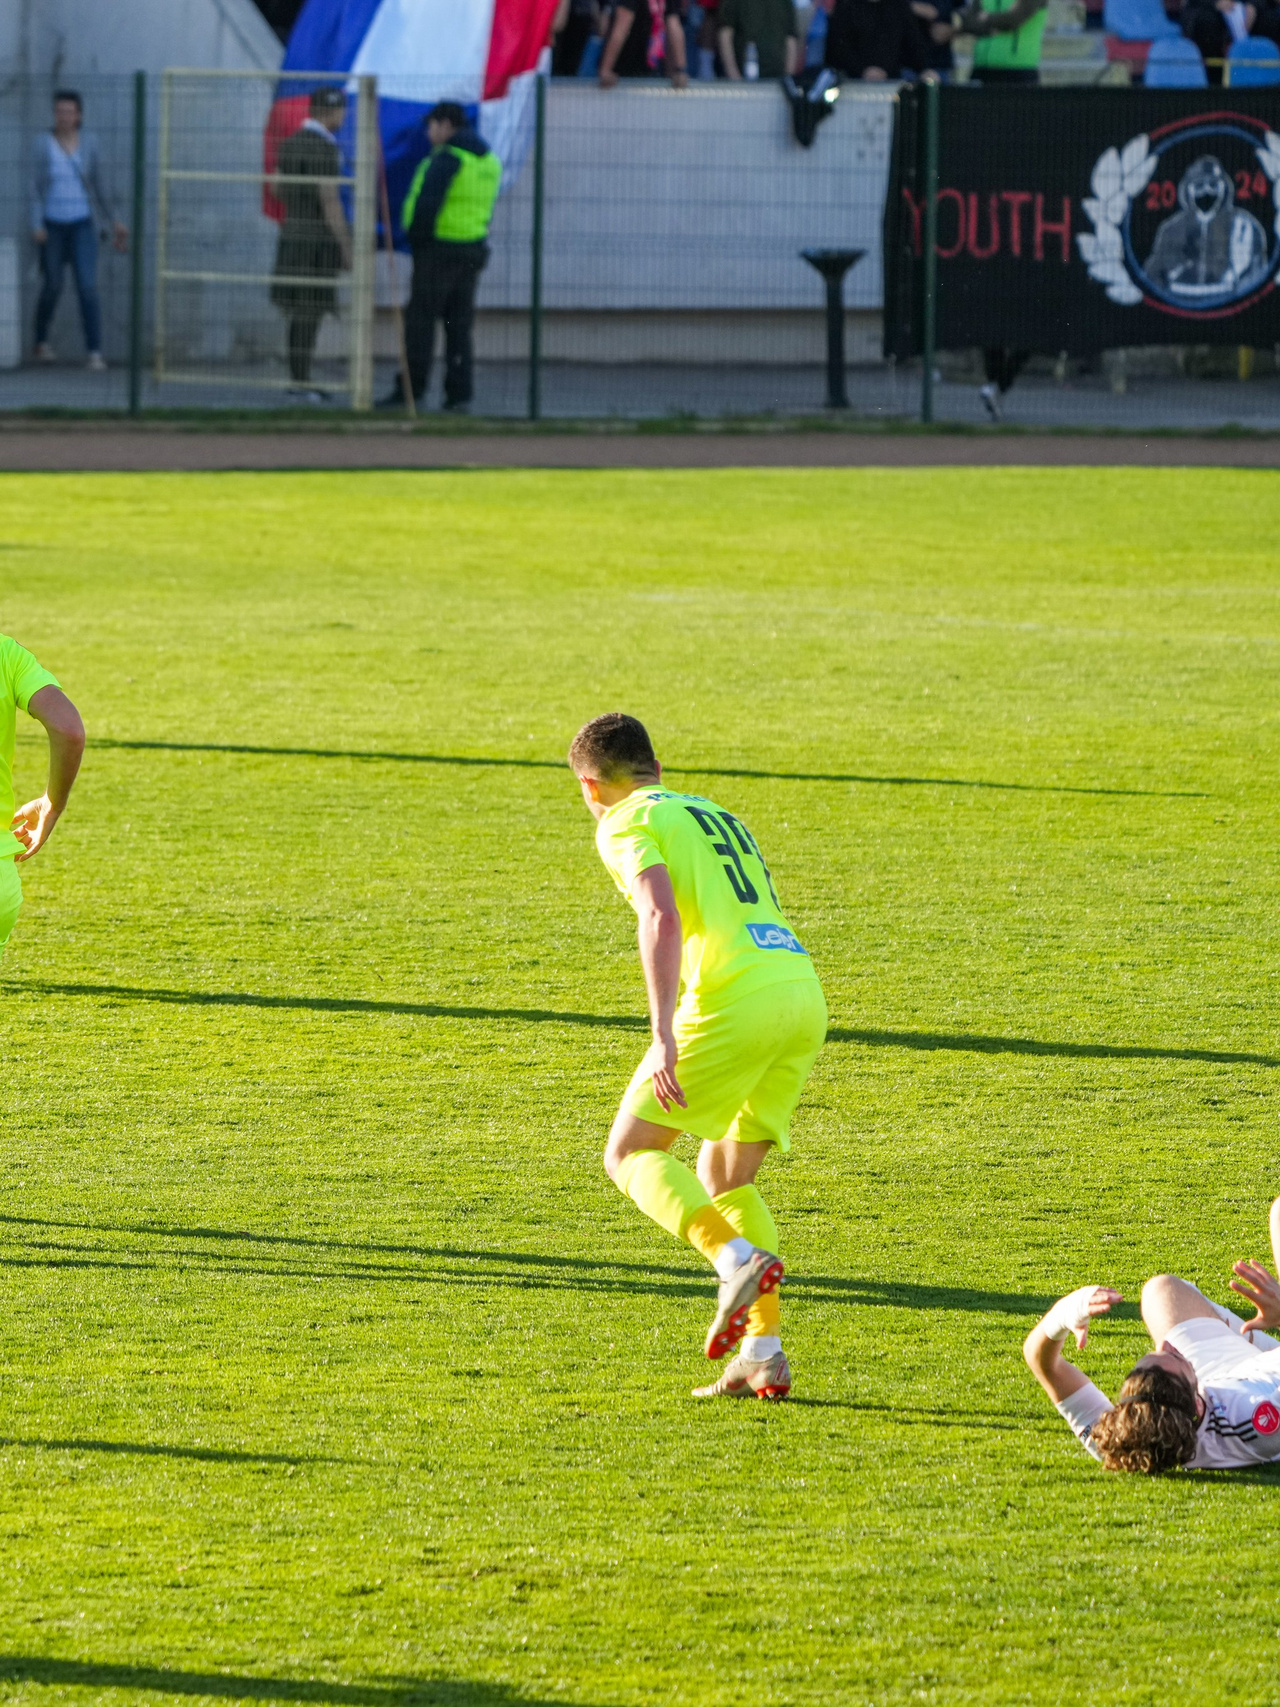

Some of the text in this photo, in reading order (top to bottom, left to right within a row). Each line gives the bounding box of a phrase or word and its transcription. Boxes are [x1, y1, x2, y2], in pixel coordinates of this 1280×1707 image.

[1146, 170, 1267, 209] 20 24
[901, 187, 1072, 263] YOUTH
